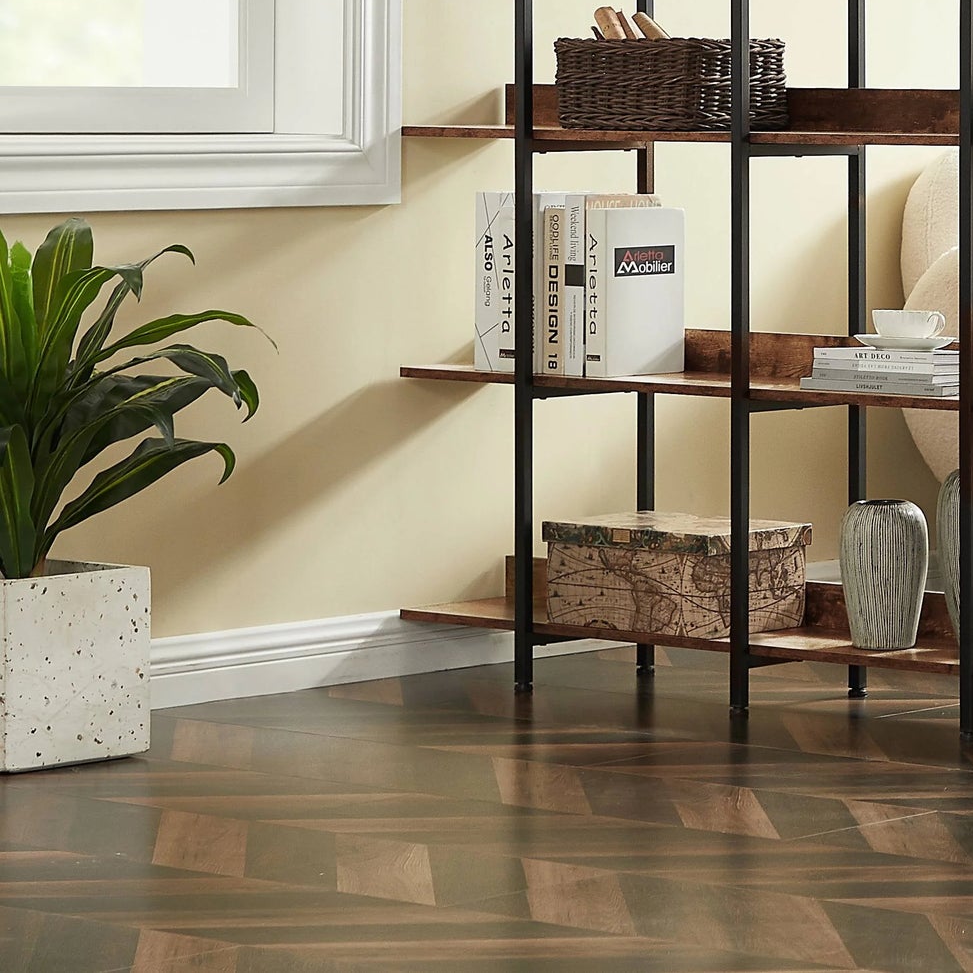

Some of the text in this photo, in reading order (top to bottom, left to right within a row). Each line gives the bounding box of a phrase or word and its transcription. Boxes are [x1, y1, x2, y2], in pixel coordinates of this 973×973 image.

[484, 234, 493, 271] ALSO
[567, 206, 580, 262] Weekend living
[616, 260, 673, 274] Mobilier
[623, 250, 665, 262] Arletta
[501, 234, 515, 334] Arletta
[589, 233, 598, 335] Arletta
[548, 265, 559, 344] DESIGN
[548, 353, 558, 370] 18
[854, 352, 868, 360] ART
